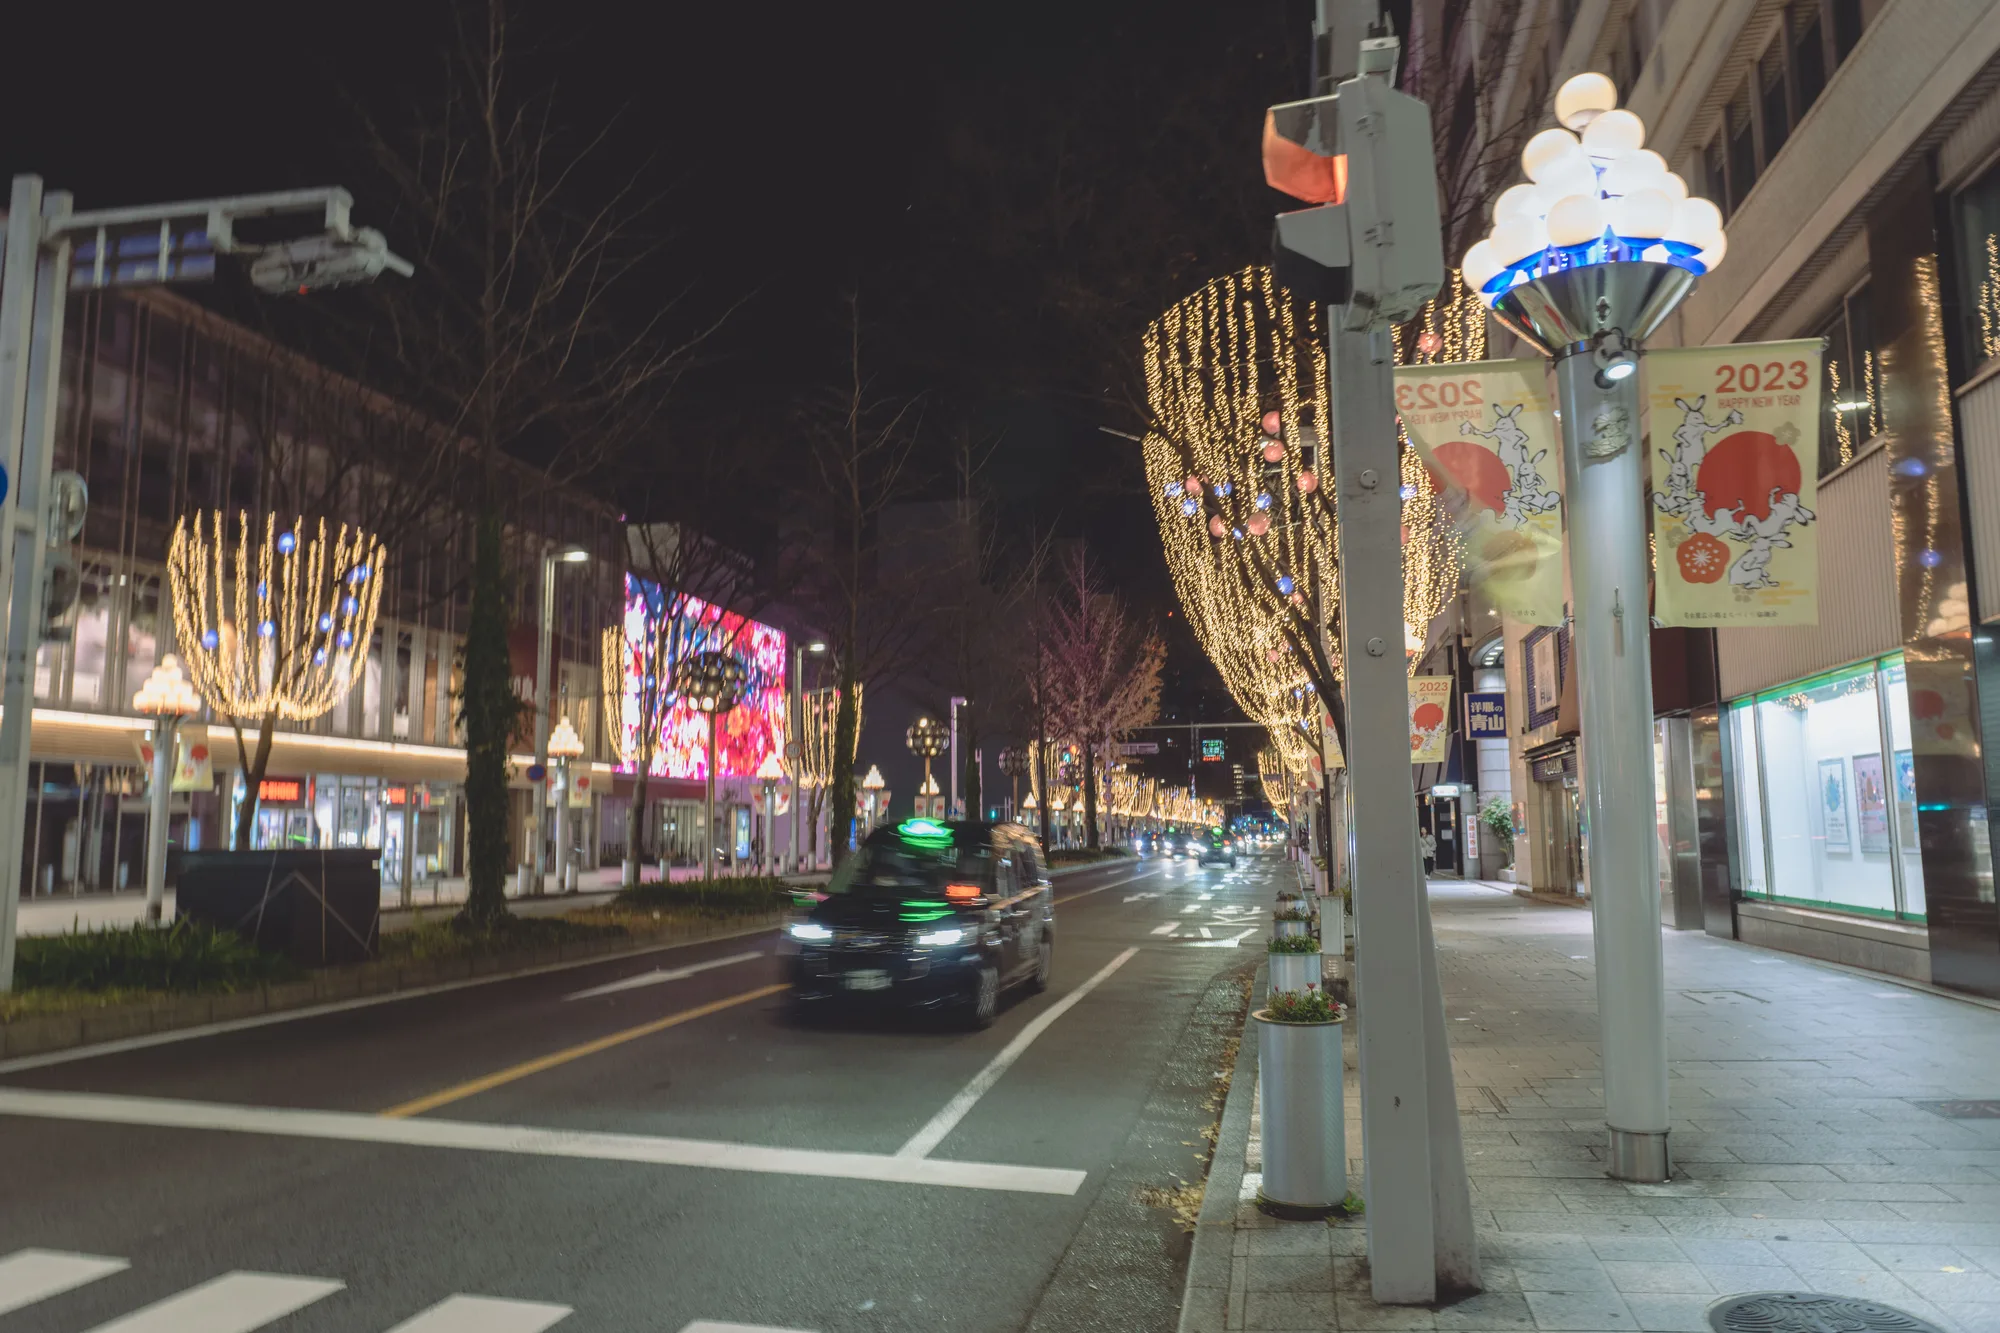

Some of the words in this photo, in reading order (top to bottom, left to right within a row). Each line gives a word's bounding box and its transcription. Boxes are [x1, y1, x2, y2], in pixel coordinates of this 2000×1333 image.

[1715, 360, 1809, 394] 2023
[1717, 397, 1749, 409] HAPPY
[1751, 395, 1774, 408] NEW
[1776, 394, 1801, 406] YEAR
[1419, 682, 1448, 692] 2023
[1470, 701, 1503, 713] 洋服の
[1470, 713, 1504, 731] 青山
